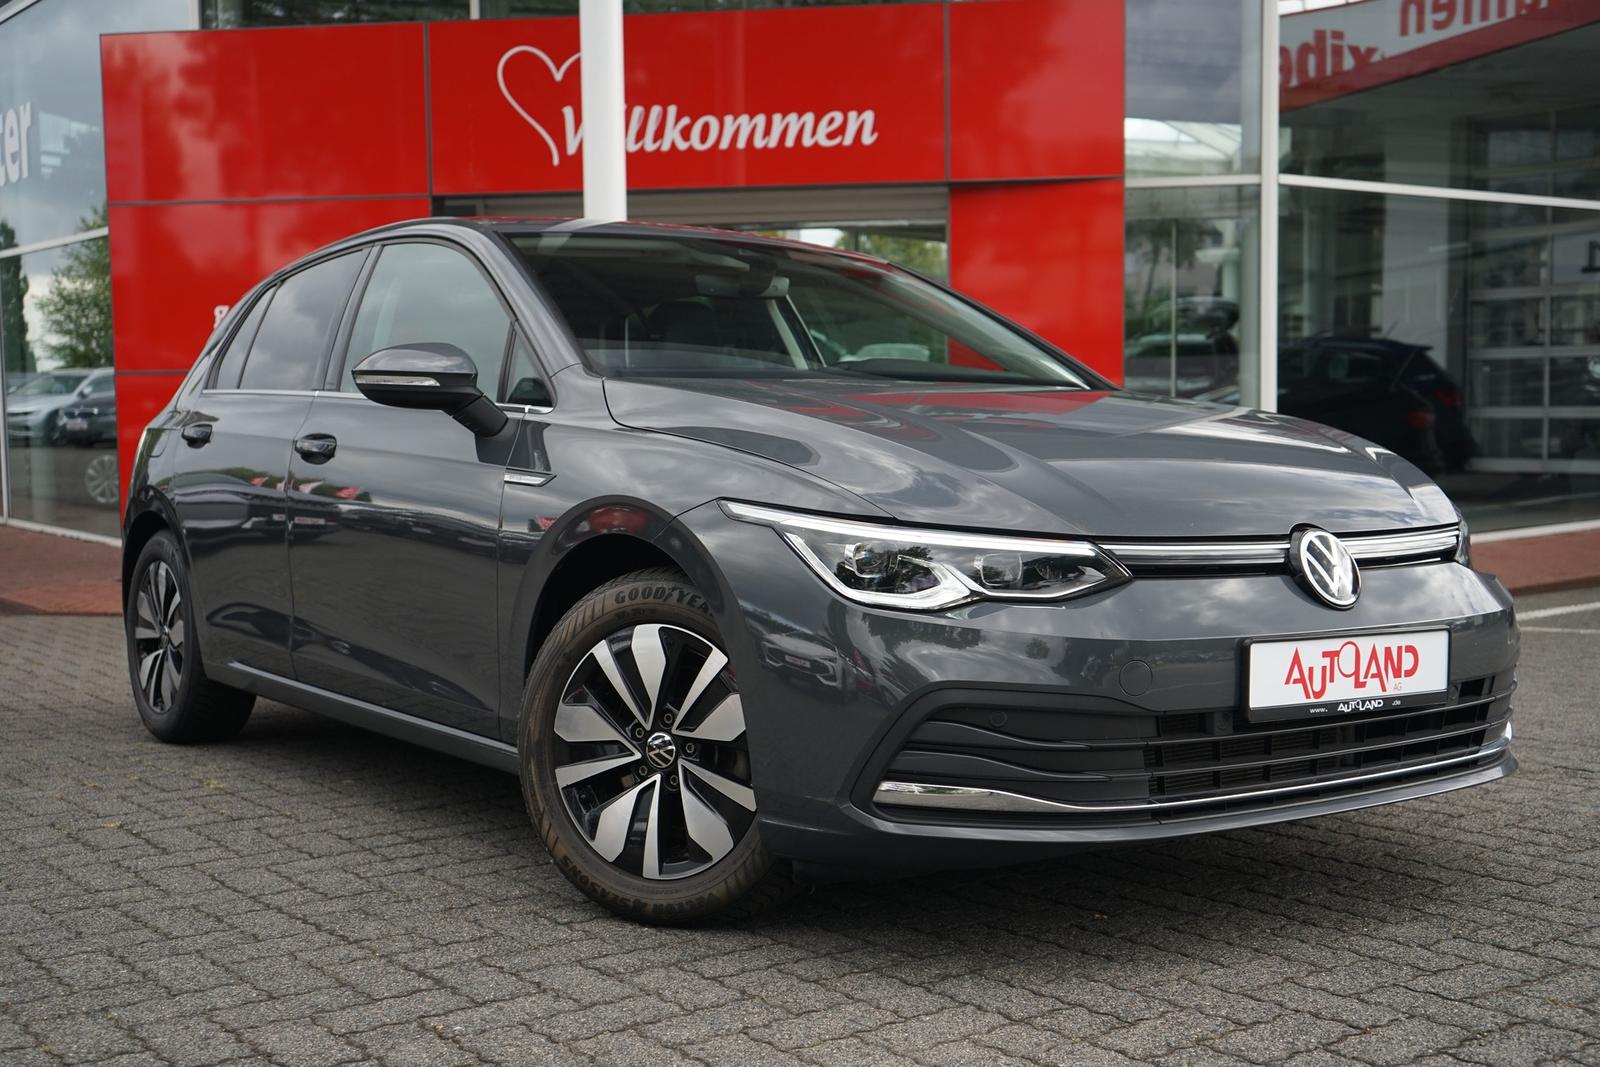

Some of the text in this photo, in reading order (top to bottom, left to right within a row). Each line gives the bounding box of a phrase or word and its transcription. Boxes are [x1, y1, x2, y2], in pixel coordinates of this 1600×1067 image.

[562, 104, 878, 156] llkommen
[614, 585, 715, 618] GOODYEA
[1284, 640, 1419, 699] AUTOLAND
